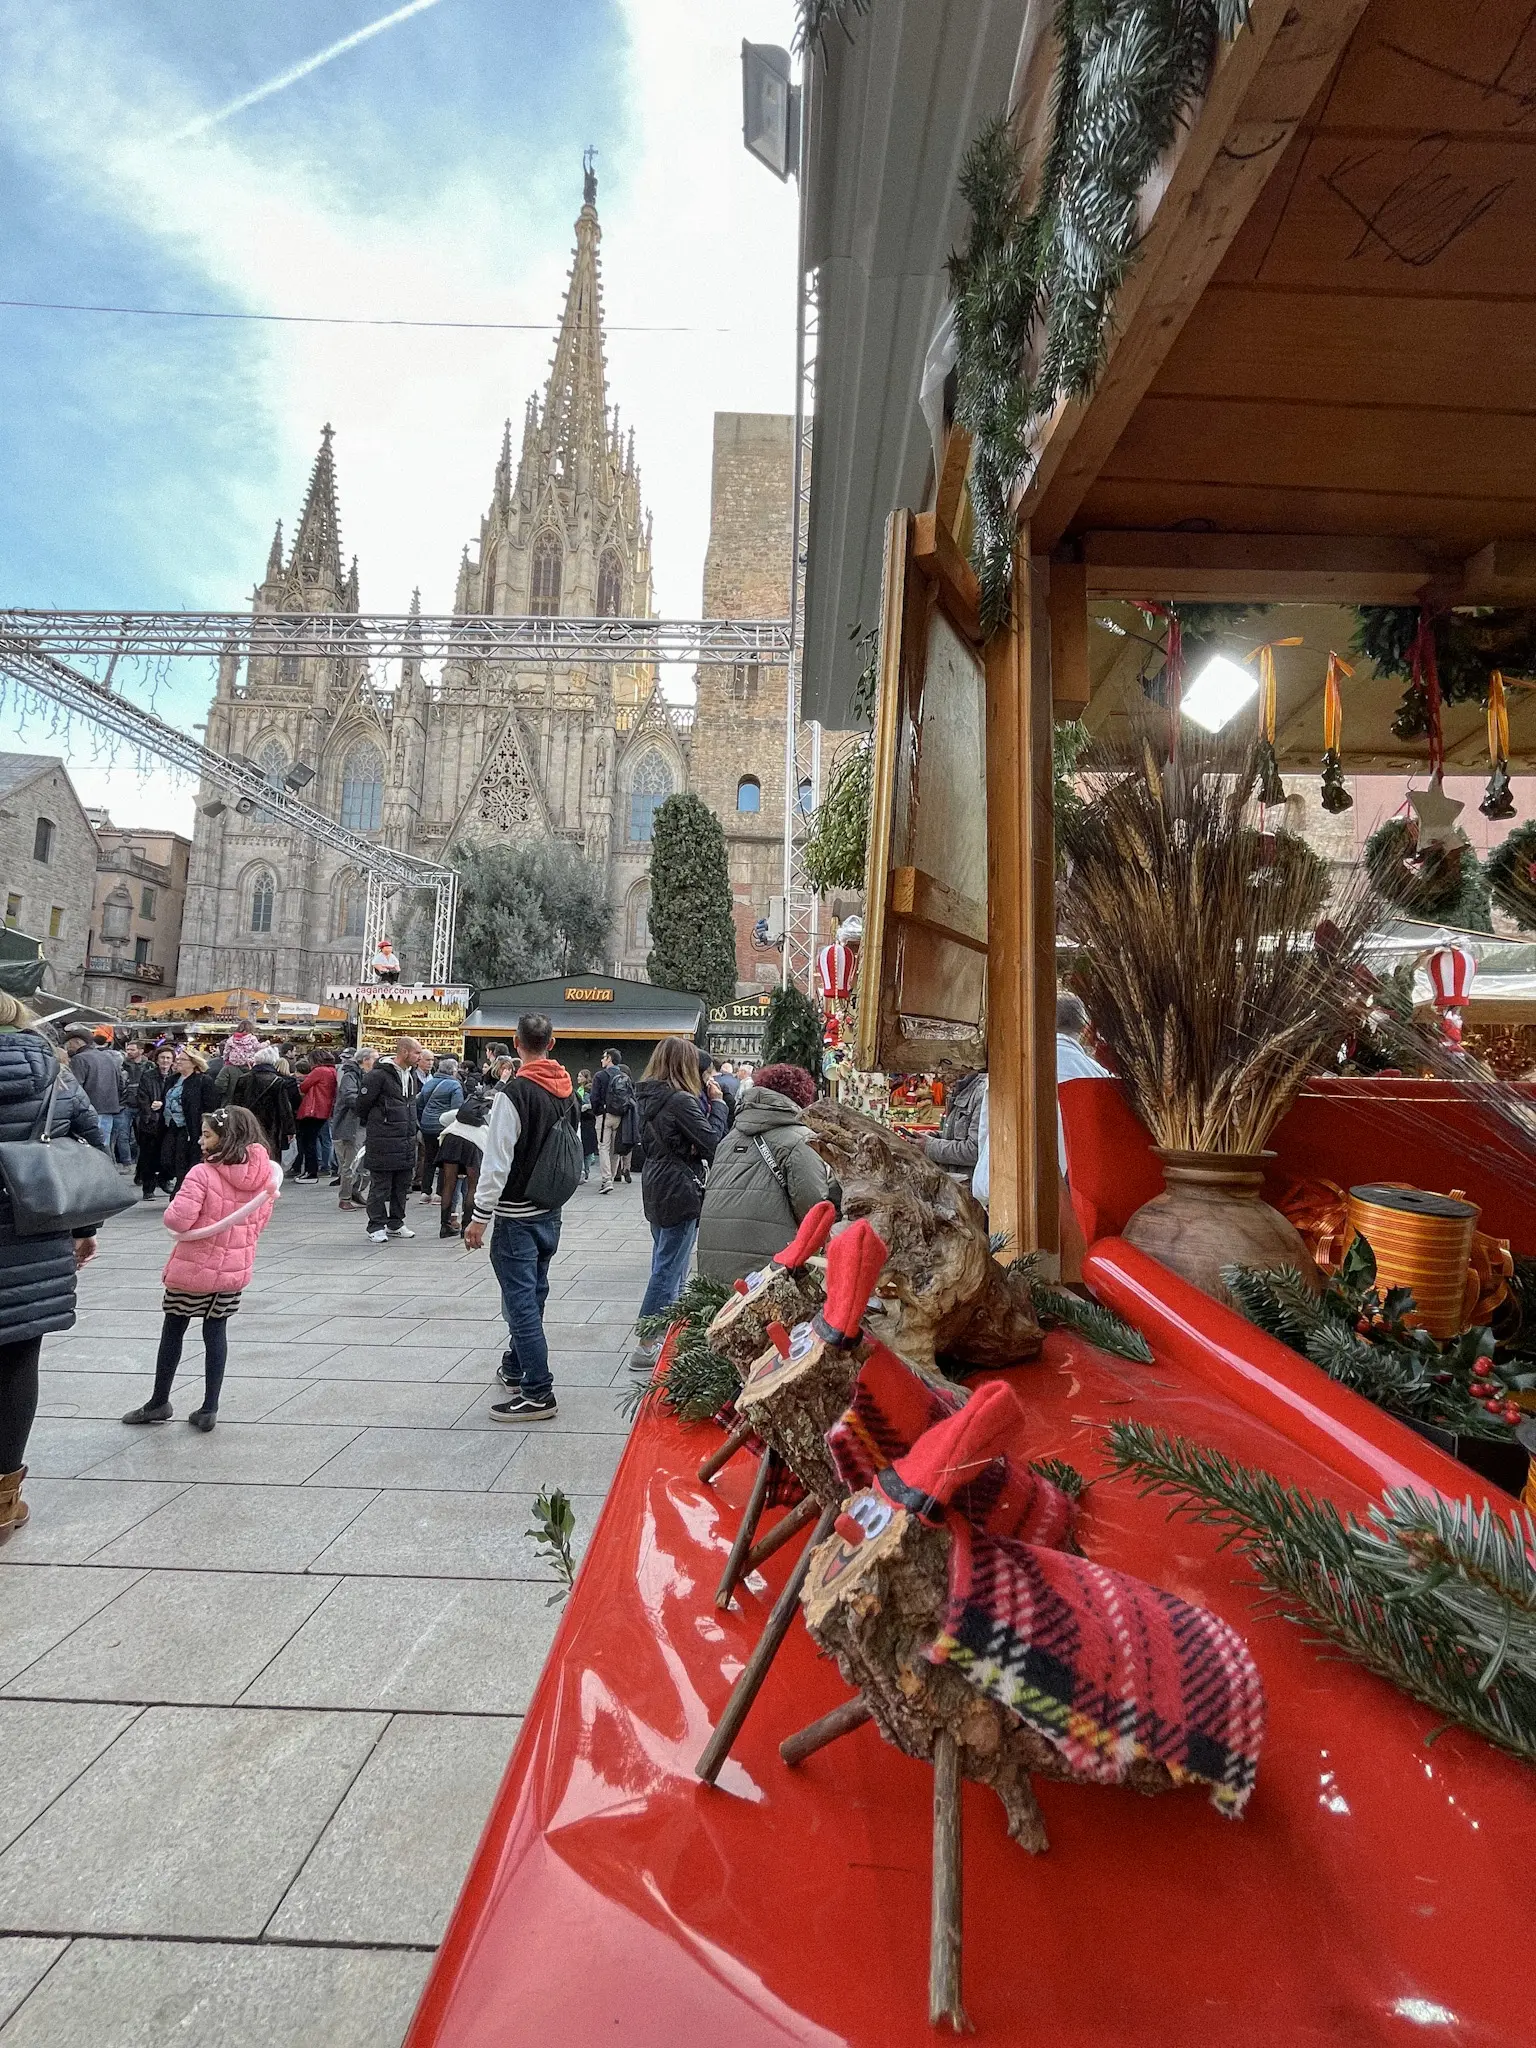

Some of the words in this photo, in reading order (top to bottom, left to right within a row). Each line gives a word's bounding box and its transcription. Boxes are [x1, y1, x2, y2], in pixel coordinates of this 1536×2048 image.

[355, 986, 413, 996] caganer.com
[566, 987, 610, 1000] Rovira
[732, 1005, 771, 1017] BERT
